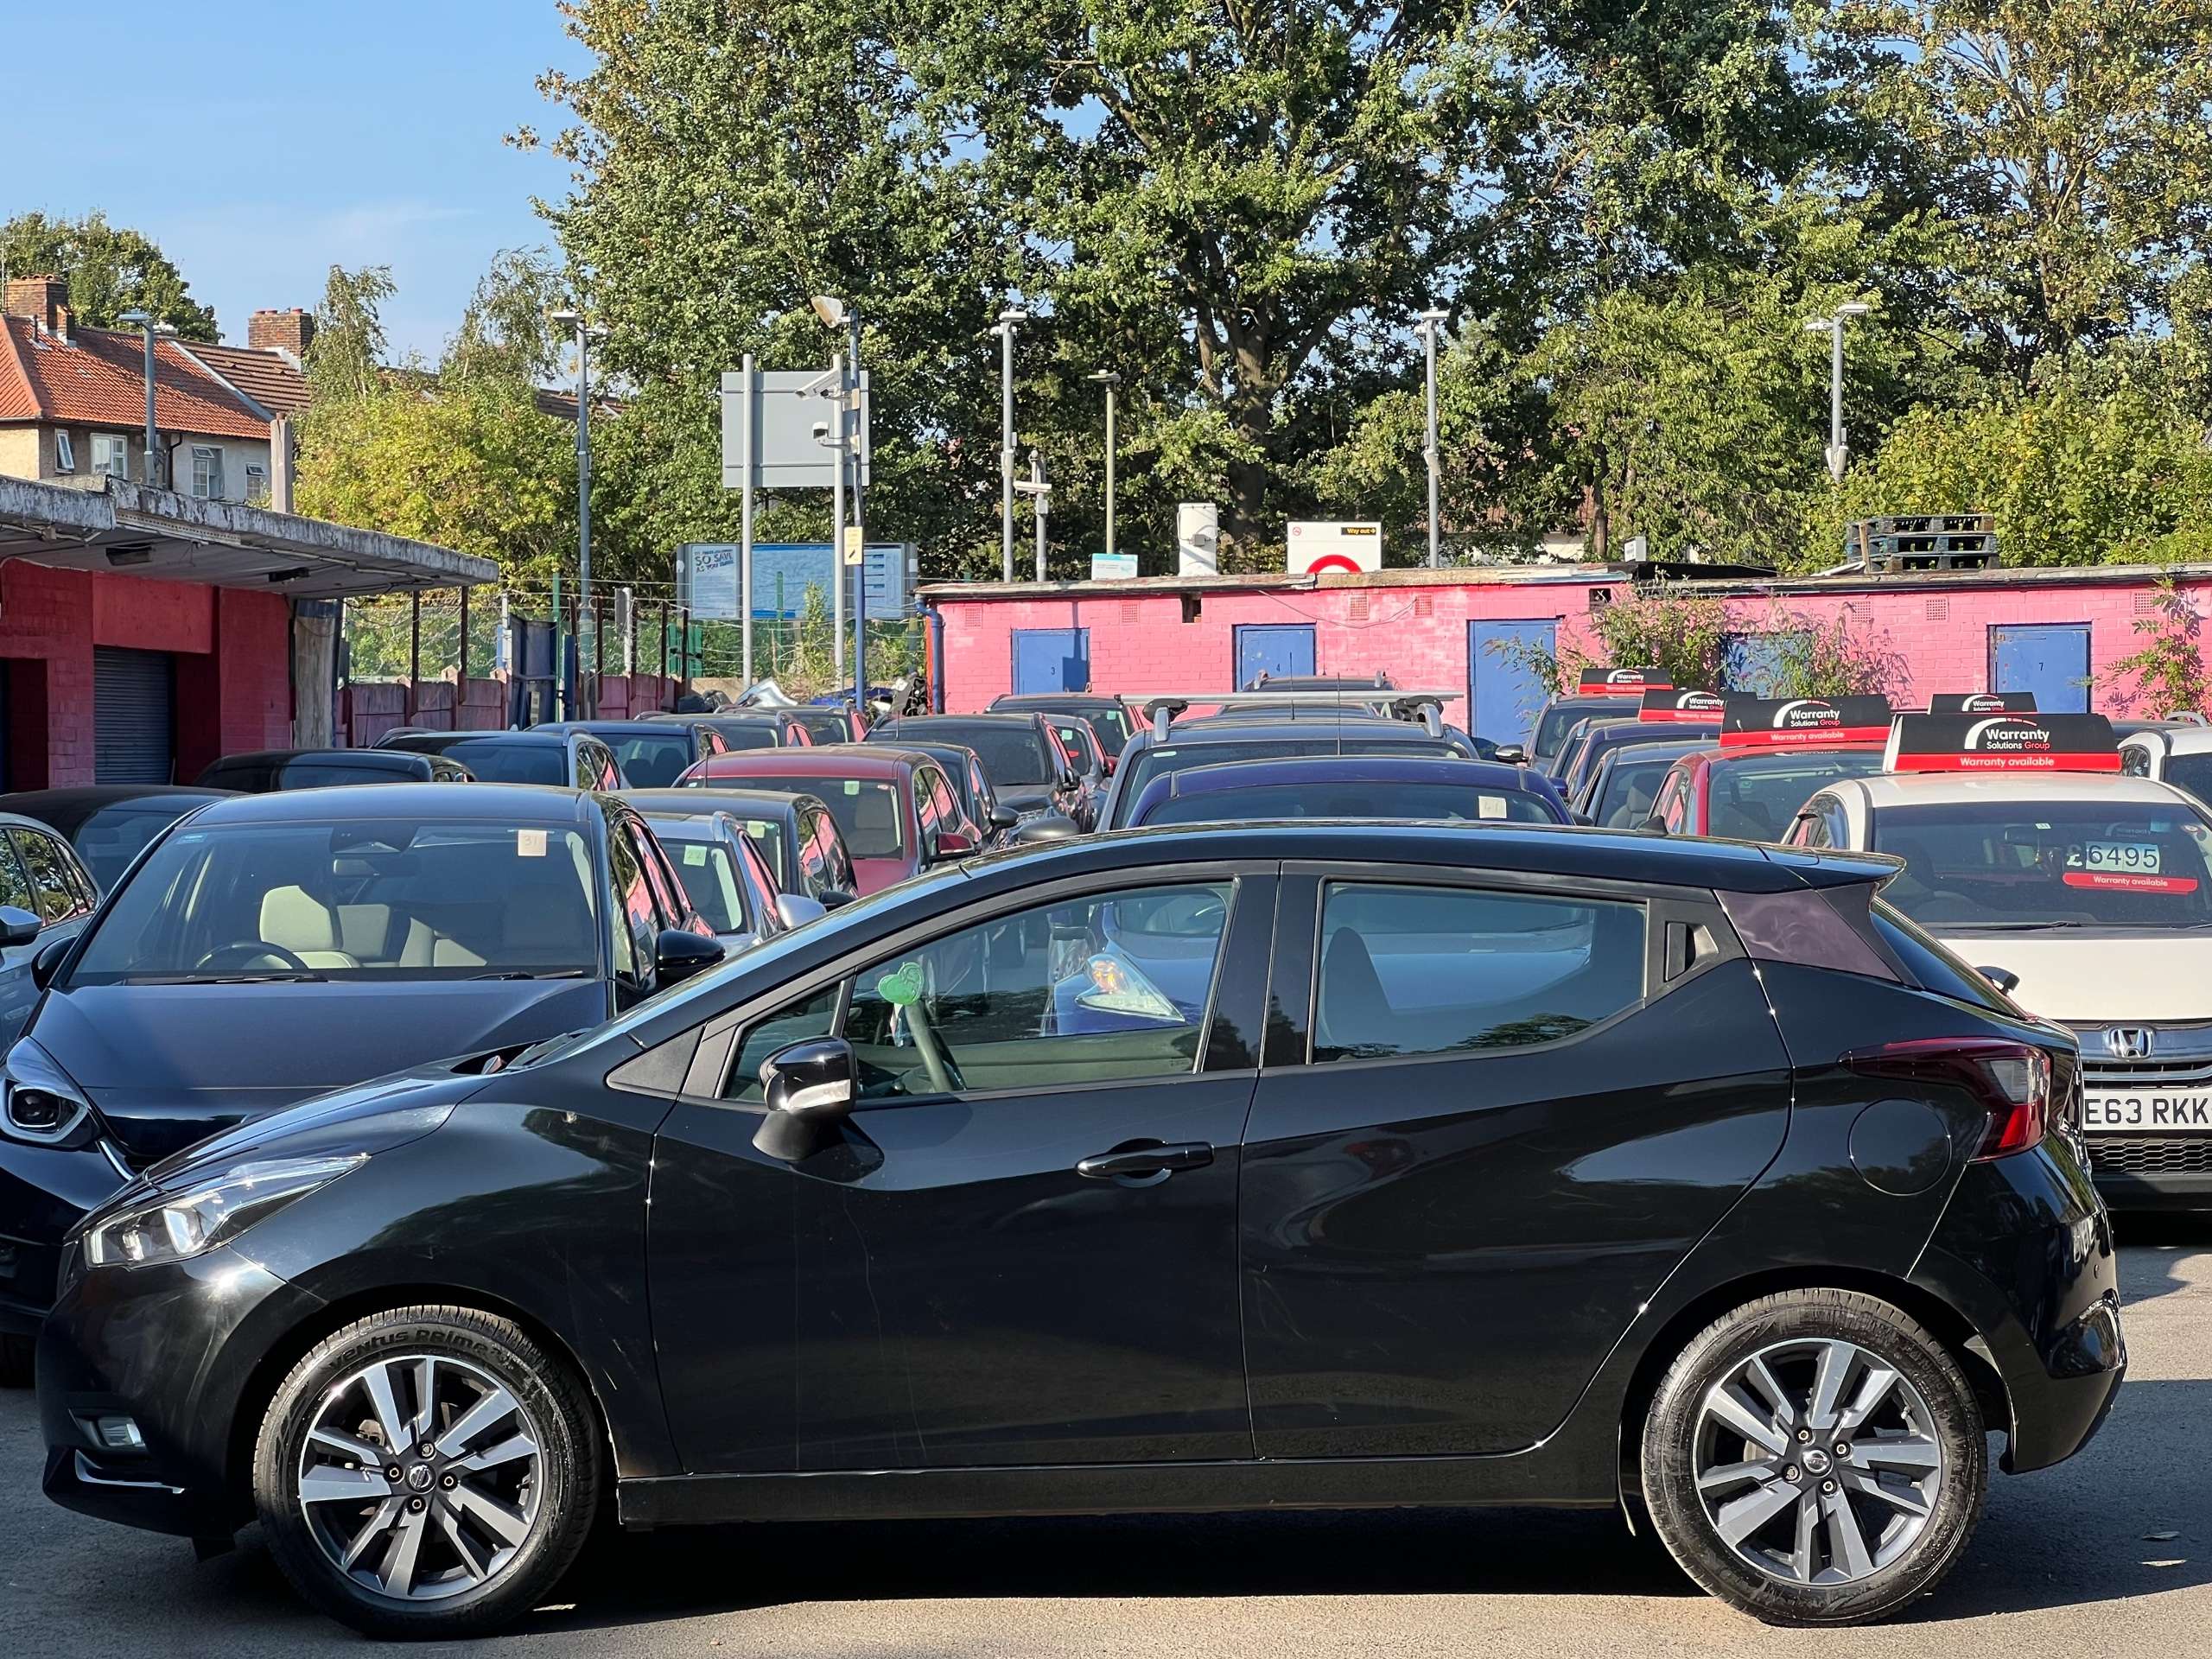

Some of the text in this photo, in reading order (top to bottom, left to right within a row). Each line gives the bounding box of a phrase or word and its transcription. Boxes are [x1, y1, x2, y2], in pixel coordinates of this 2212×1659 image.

[695, 556, 711, 566] SO
[1051, 666, 1055, 676] 3
[2038, 662, 2044, 671] 7
[1689, 697, 1725, 707] Warranty
[1789, 709, 1840, 721] Warranty
[1770, 731, 1845, 742] Warranty available
[1986, 728, 2050, 743] Warranty
[1986, 741, 2051, 751] Solutions Group
[1960, 756, 2055, 768] Warranty available
[2094, 875, 2169, 887] Warranty available
[2084, 1097, 2209, 1124] E63 RKK
